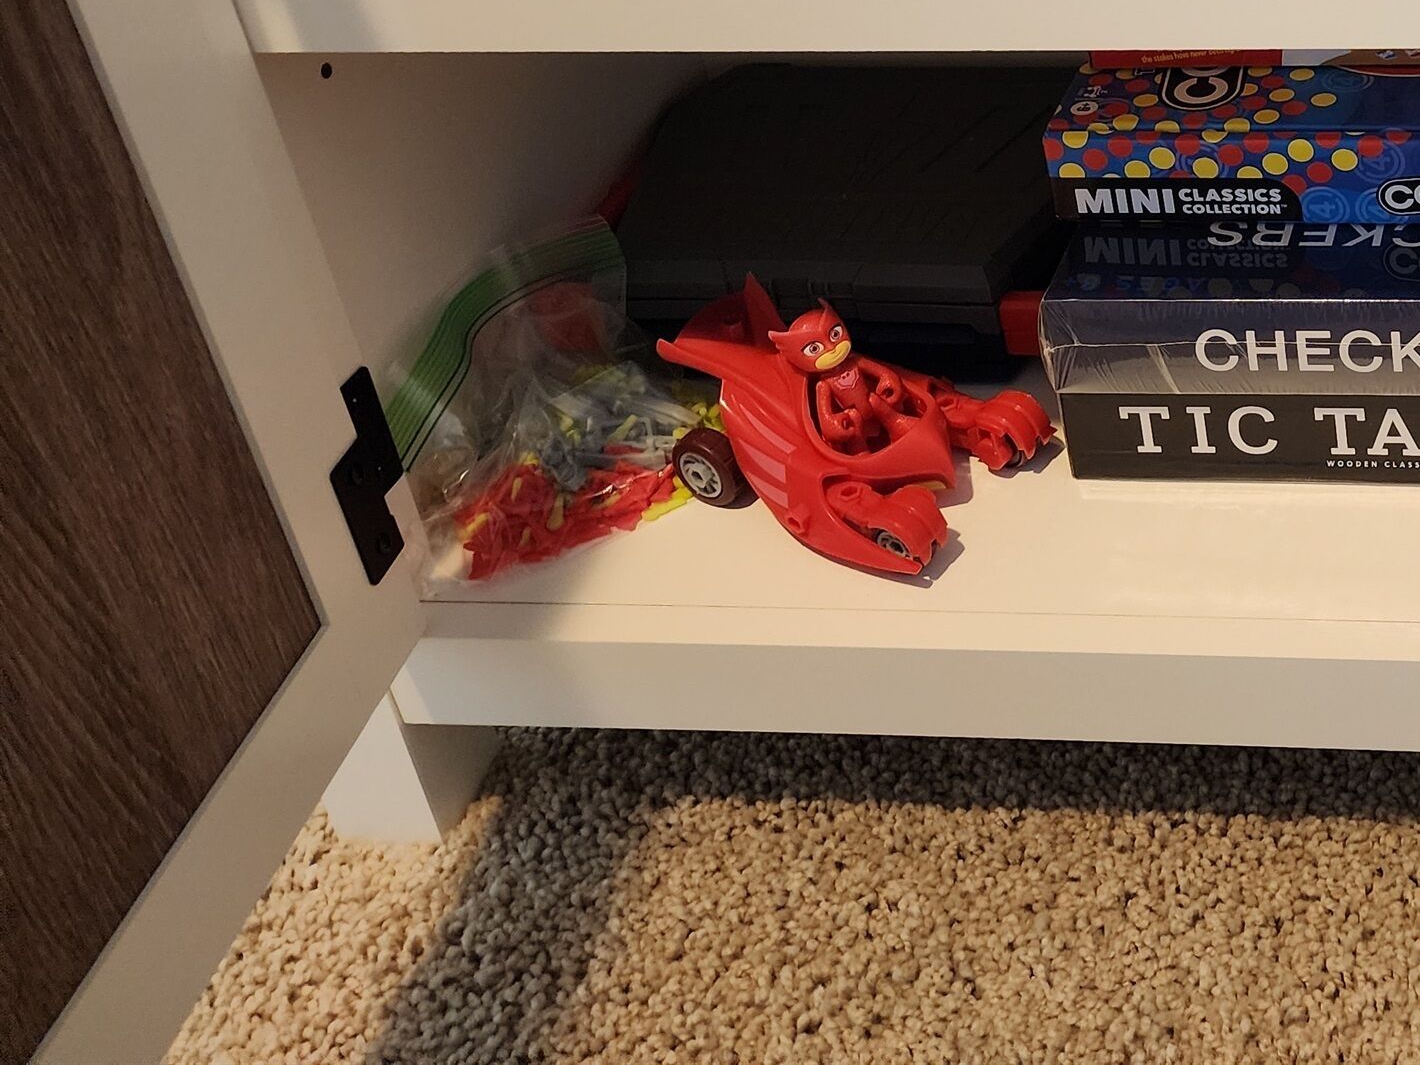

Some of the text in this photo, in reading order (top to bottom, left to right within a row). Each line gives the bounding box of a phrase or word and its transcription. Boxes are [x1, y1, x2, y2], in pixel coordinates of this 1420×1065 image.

[1076, 185, 1177, 216] MINI
[1178, 186, 1282, 204] CLASSICS
[1182, 201, 1283, 215] COLLECTION
[1117, 404, 1279, 457] TIC
[1326, 460, 1379, 469] WOODEN
